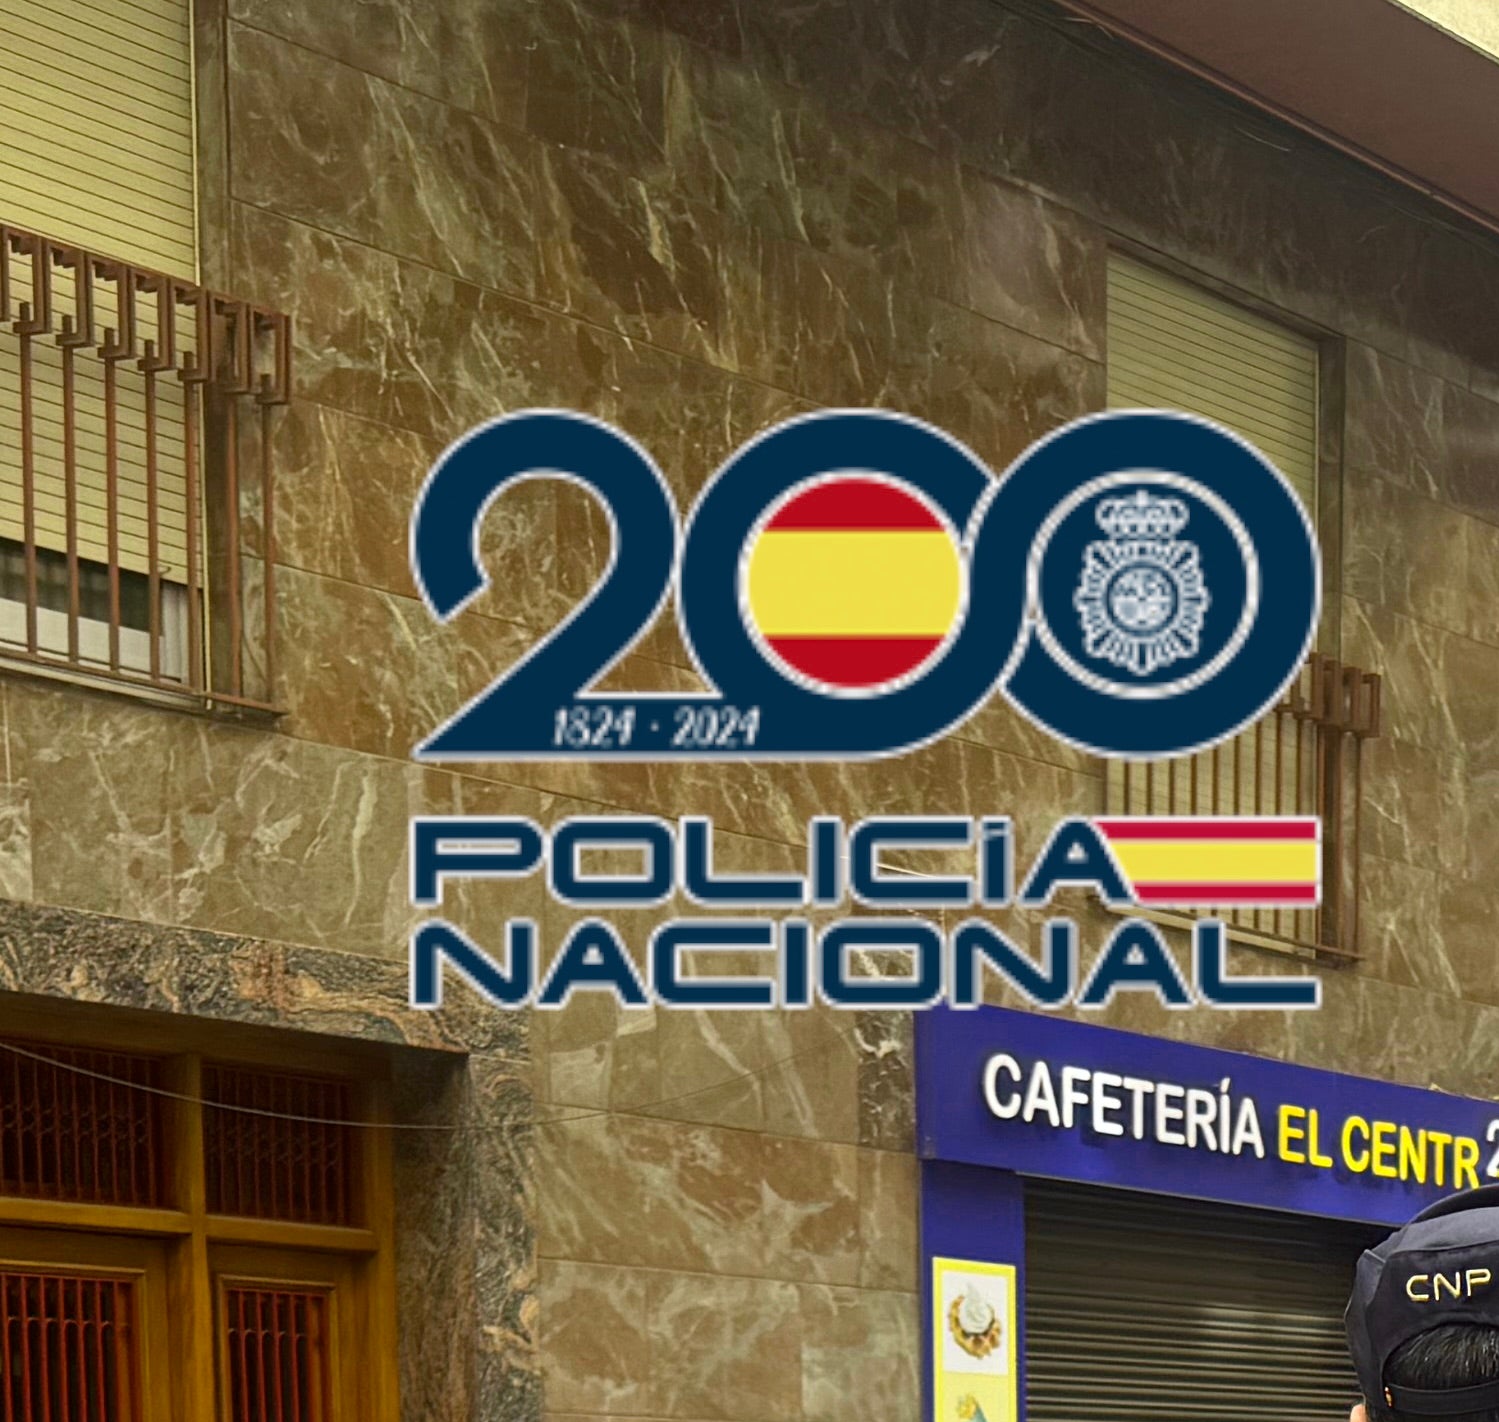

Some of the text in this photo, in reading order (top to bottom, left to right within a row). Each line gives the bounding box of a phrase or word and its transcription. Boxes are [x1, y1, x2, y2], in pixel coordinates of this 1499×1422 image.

[984, 1053, 1265, 1159] CAFETERÍA
[1278, 1104, 1333, 1168] EL
[1406, 1268, 1491, 1302] CNP
